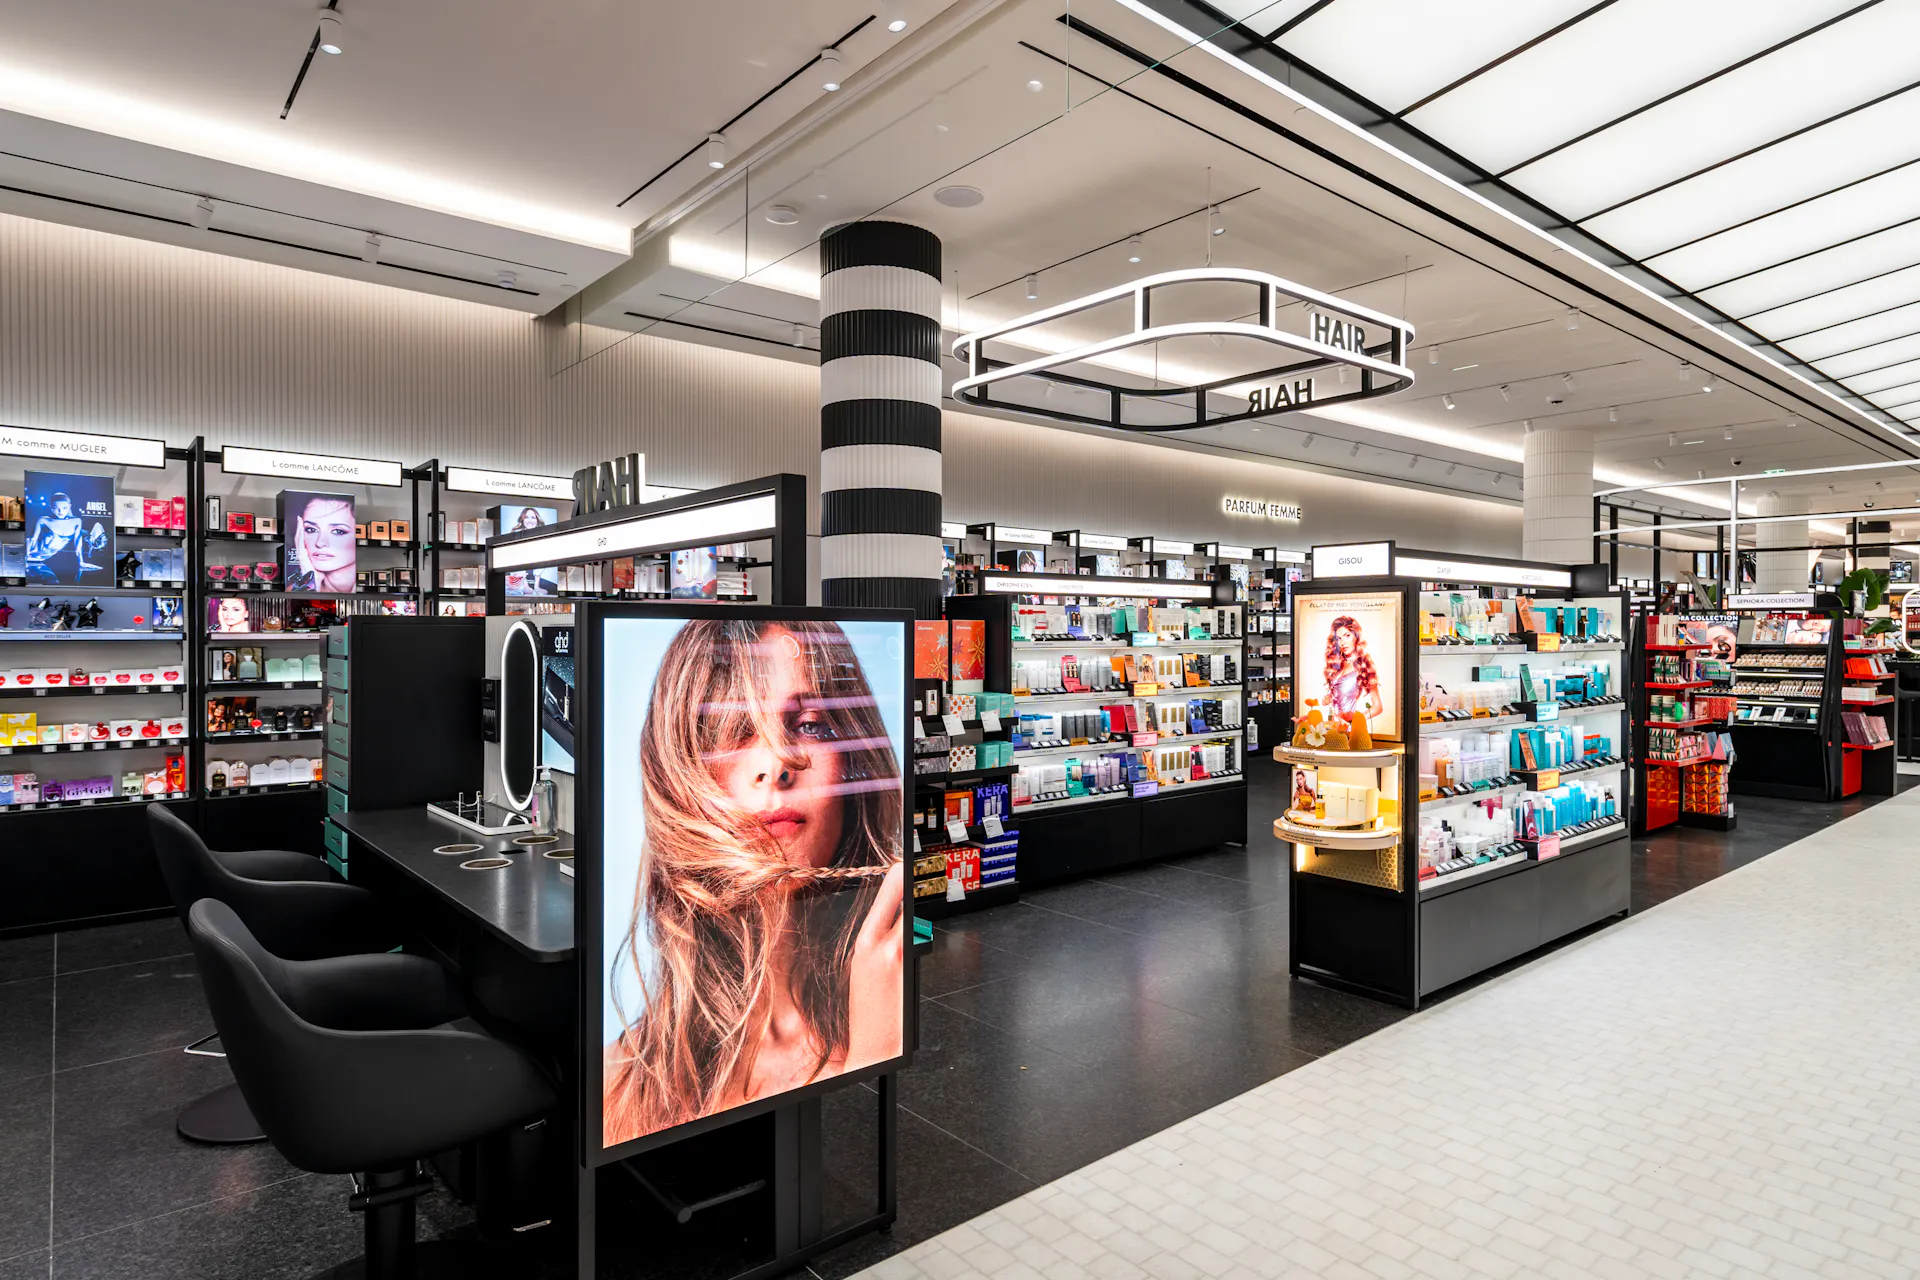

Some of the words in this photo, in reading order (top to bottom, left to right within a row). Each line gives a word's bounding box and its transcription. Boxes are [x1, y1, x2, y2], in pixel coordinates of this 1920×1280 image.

[1310, 312, 1366, 356] HAIR
[1, 437, 13, 445] M
[17, 440, 56, 450] comme
[60, 443, 108, 454] MUGLER
[272, 460, 277, 468] L
[279, 462, 309, 471] comme
[312, 461, 359, 475] LANCÔME
[486, 478, 490, 486] L
[518, 481, 556, 492] LANCÔME
[86, 501, 107, 512] ANGEL
[1225, 498, 1267, 516] PARFUM
[1270, 504, 1302, 520] FEMME
[1338, 557, 1363, 565] GISOU
[554, 631, 569, 654] ghd
[977, 784, 1008, 799] KERA
[945, 849, 980, 863] KERA
